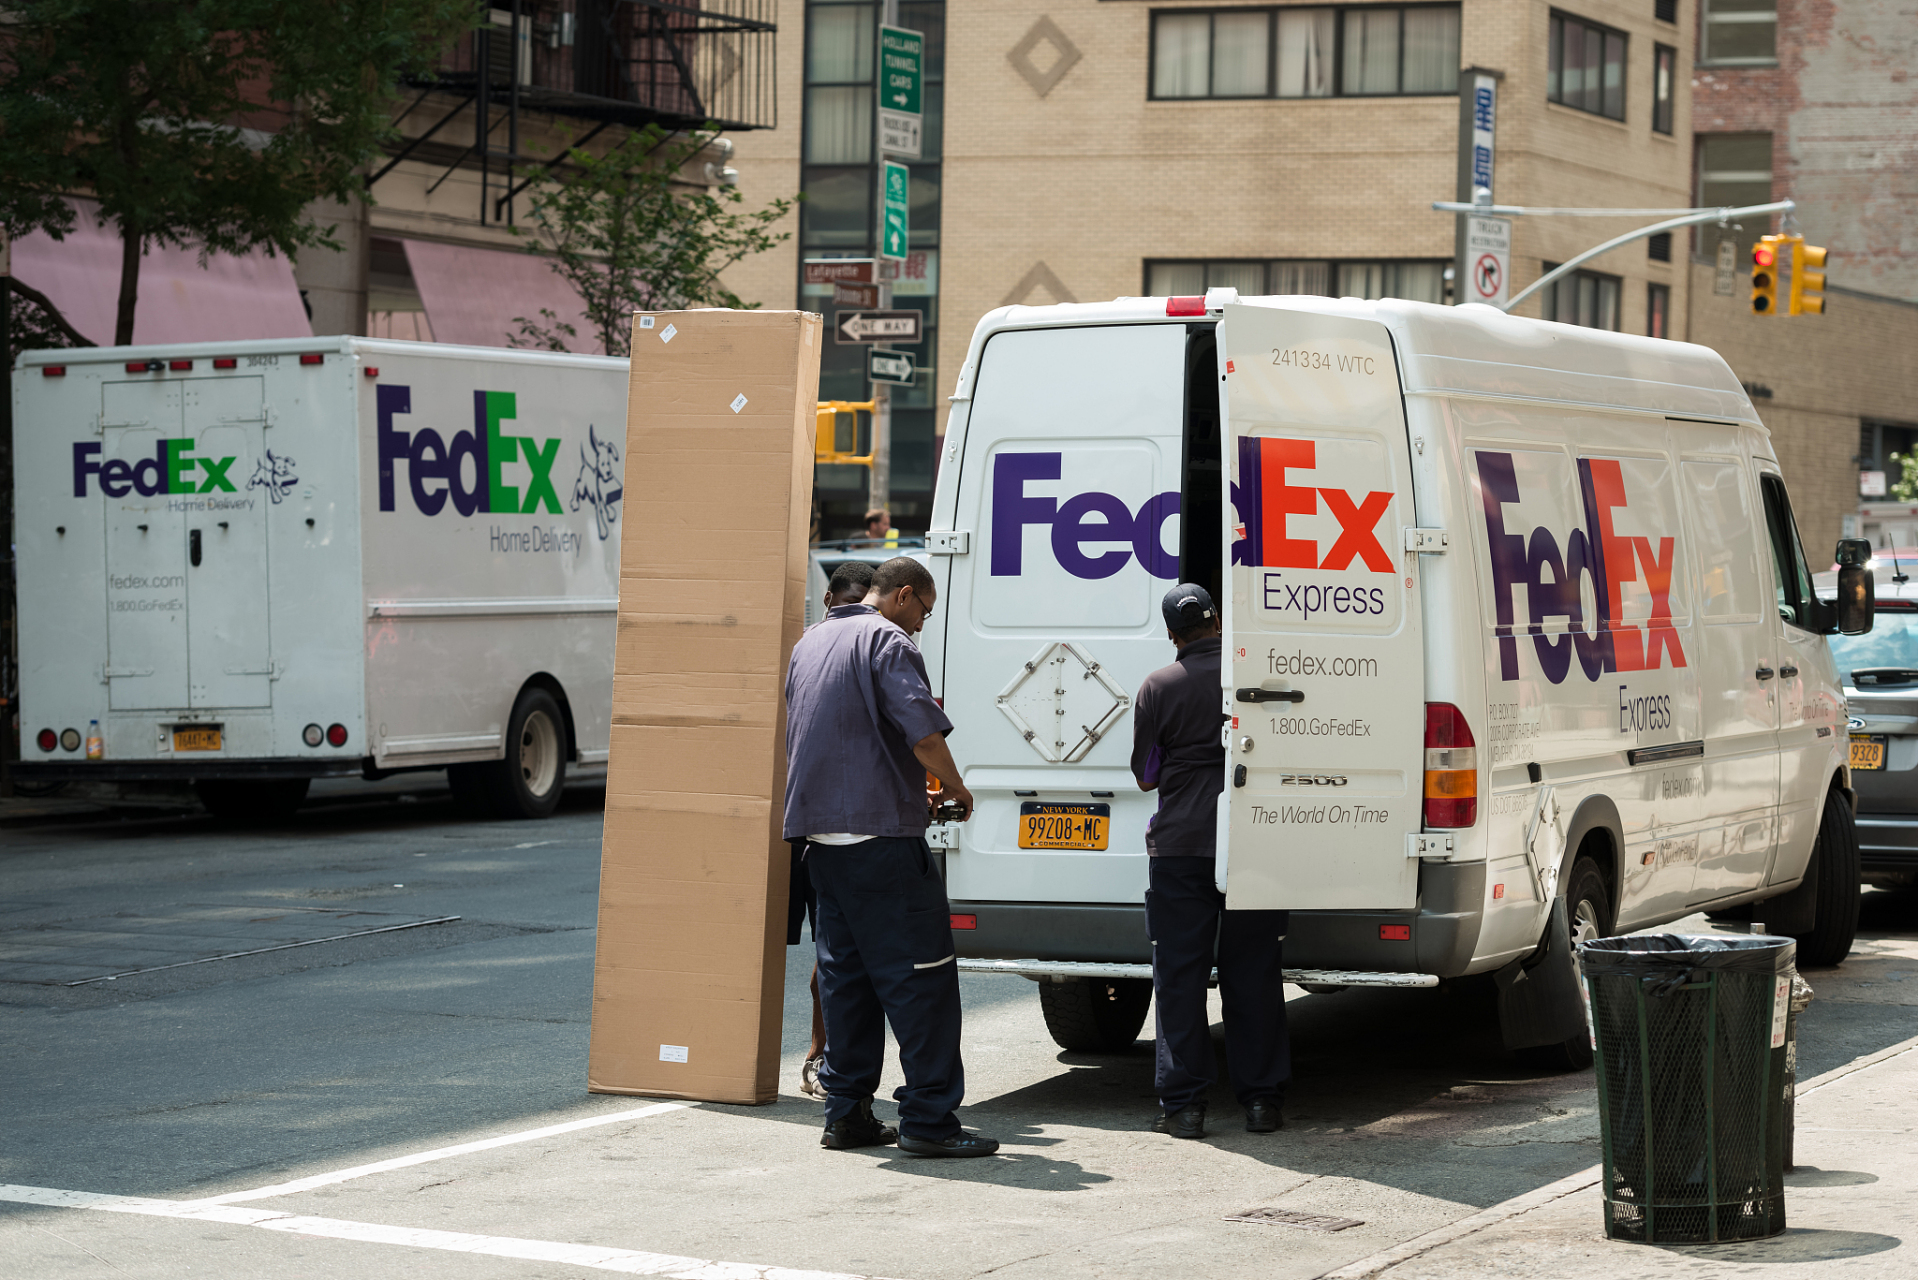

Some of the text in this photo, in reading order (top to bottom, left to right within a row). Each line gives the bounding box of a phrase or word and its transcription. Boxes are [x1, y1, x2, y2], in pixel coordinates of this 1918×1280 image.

[882, 35, 920, 55] HOLLAND
[884, 54, 918, 73] TUNNEL
[889, 73, 912, 90] CARS
[1476, 220, 1503, 235] TRUCK
[807, 265, 859, 279] Lafayette
[852, 320, 908, 332] ONE WAY
[877, 360, 908, 373] ONE WAY
[1272, 348, 1375, 375] 241334 WTC
[376, 384, 564, 517] FedEx
[73, 438, 238, 498] FedEx
[168, 497, 254, 512] Home Delivery
[490, 525, 582, 558] Home Delivery
[1474, 451, 1687, 684] FedEx
[109, 574, 184, 589] fedex.com
[1263, 573, 1385, 621] Express
[1267, 648, 1378, 677] fedex.com
[1619, 685, 1671, 744] Express
[1269, 717, 1371, 737] 1.800.GoFedEx
[1852, 745, 1879, 761] 9328
[1280, 773, 1348, 787] 2500
[1042, 806, 1088, 814] NEW YORK
[1251, 805, 1389, 824] The World On Time
